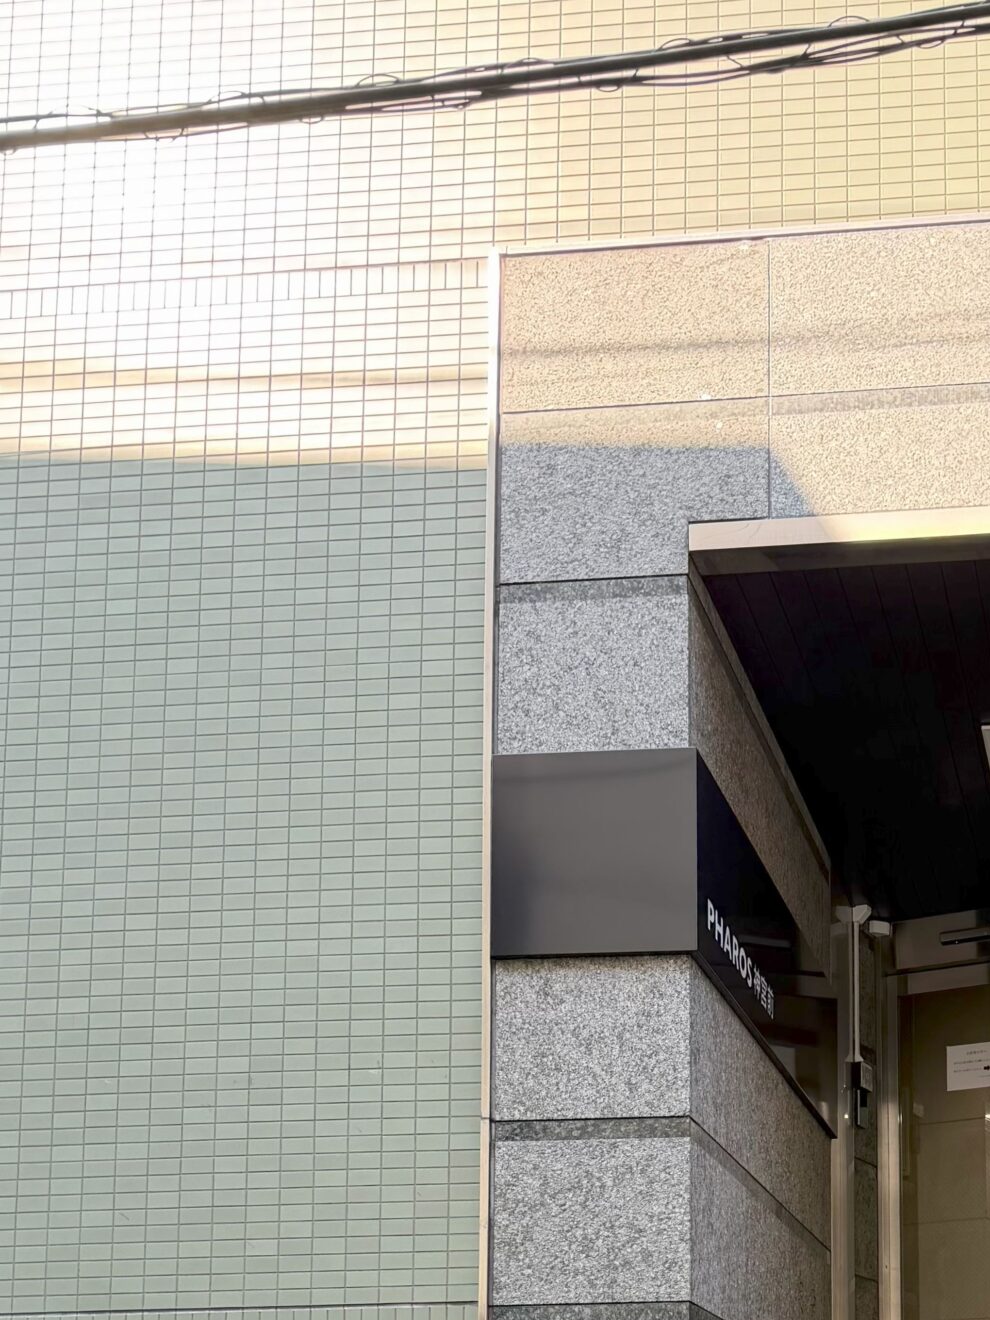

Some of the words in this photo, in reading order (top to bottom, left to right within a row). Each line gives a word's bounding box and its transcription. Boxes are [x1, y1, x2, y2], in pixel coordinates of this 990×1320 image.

[707, 898, 753, 988] PHAROS
[753, 963, 774, 1020] 神宮前
